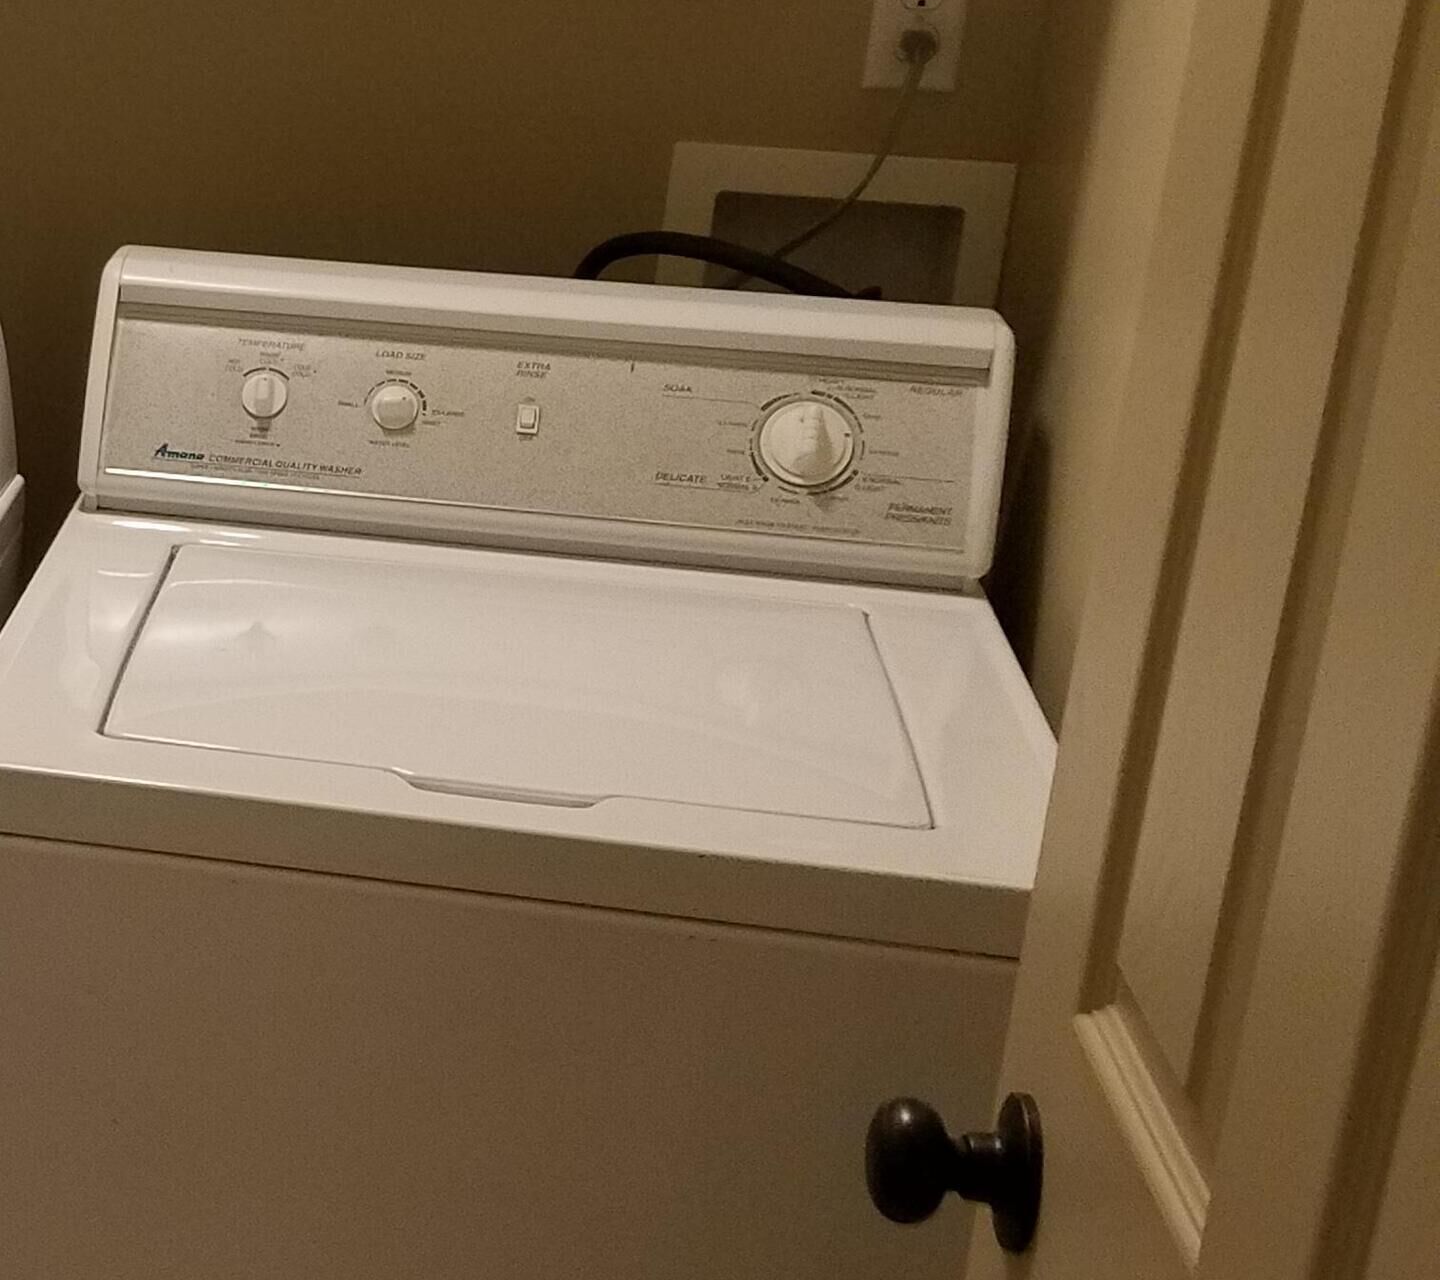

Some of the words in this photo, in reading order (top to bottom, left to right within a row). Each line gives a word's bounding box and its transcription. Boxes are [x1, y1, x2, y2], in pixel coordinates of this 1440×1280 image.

[375, 350, 403, 360] LOAD
[516, 361, 551, 371] EXTRA
[515, 369, 547, 378] RINSE
[153, 443, 205, 461] Amana
[208, 453, 273, 468] COMMERCIAL
[274, 460, 318, 471] QUALITY
[318, 464, 362, 476] WASHER
[655, 471, 707, 484] DELICATE
[887, 502, 953, 516] PERMANENT
